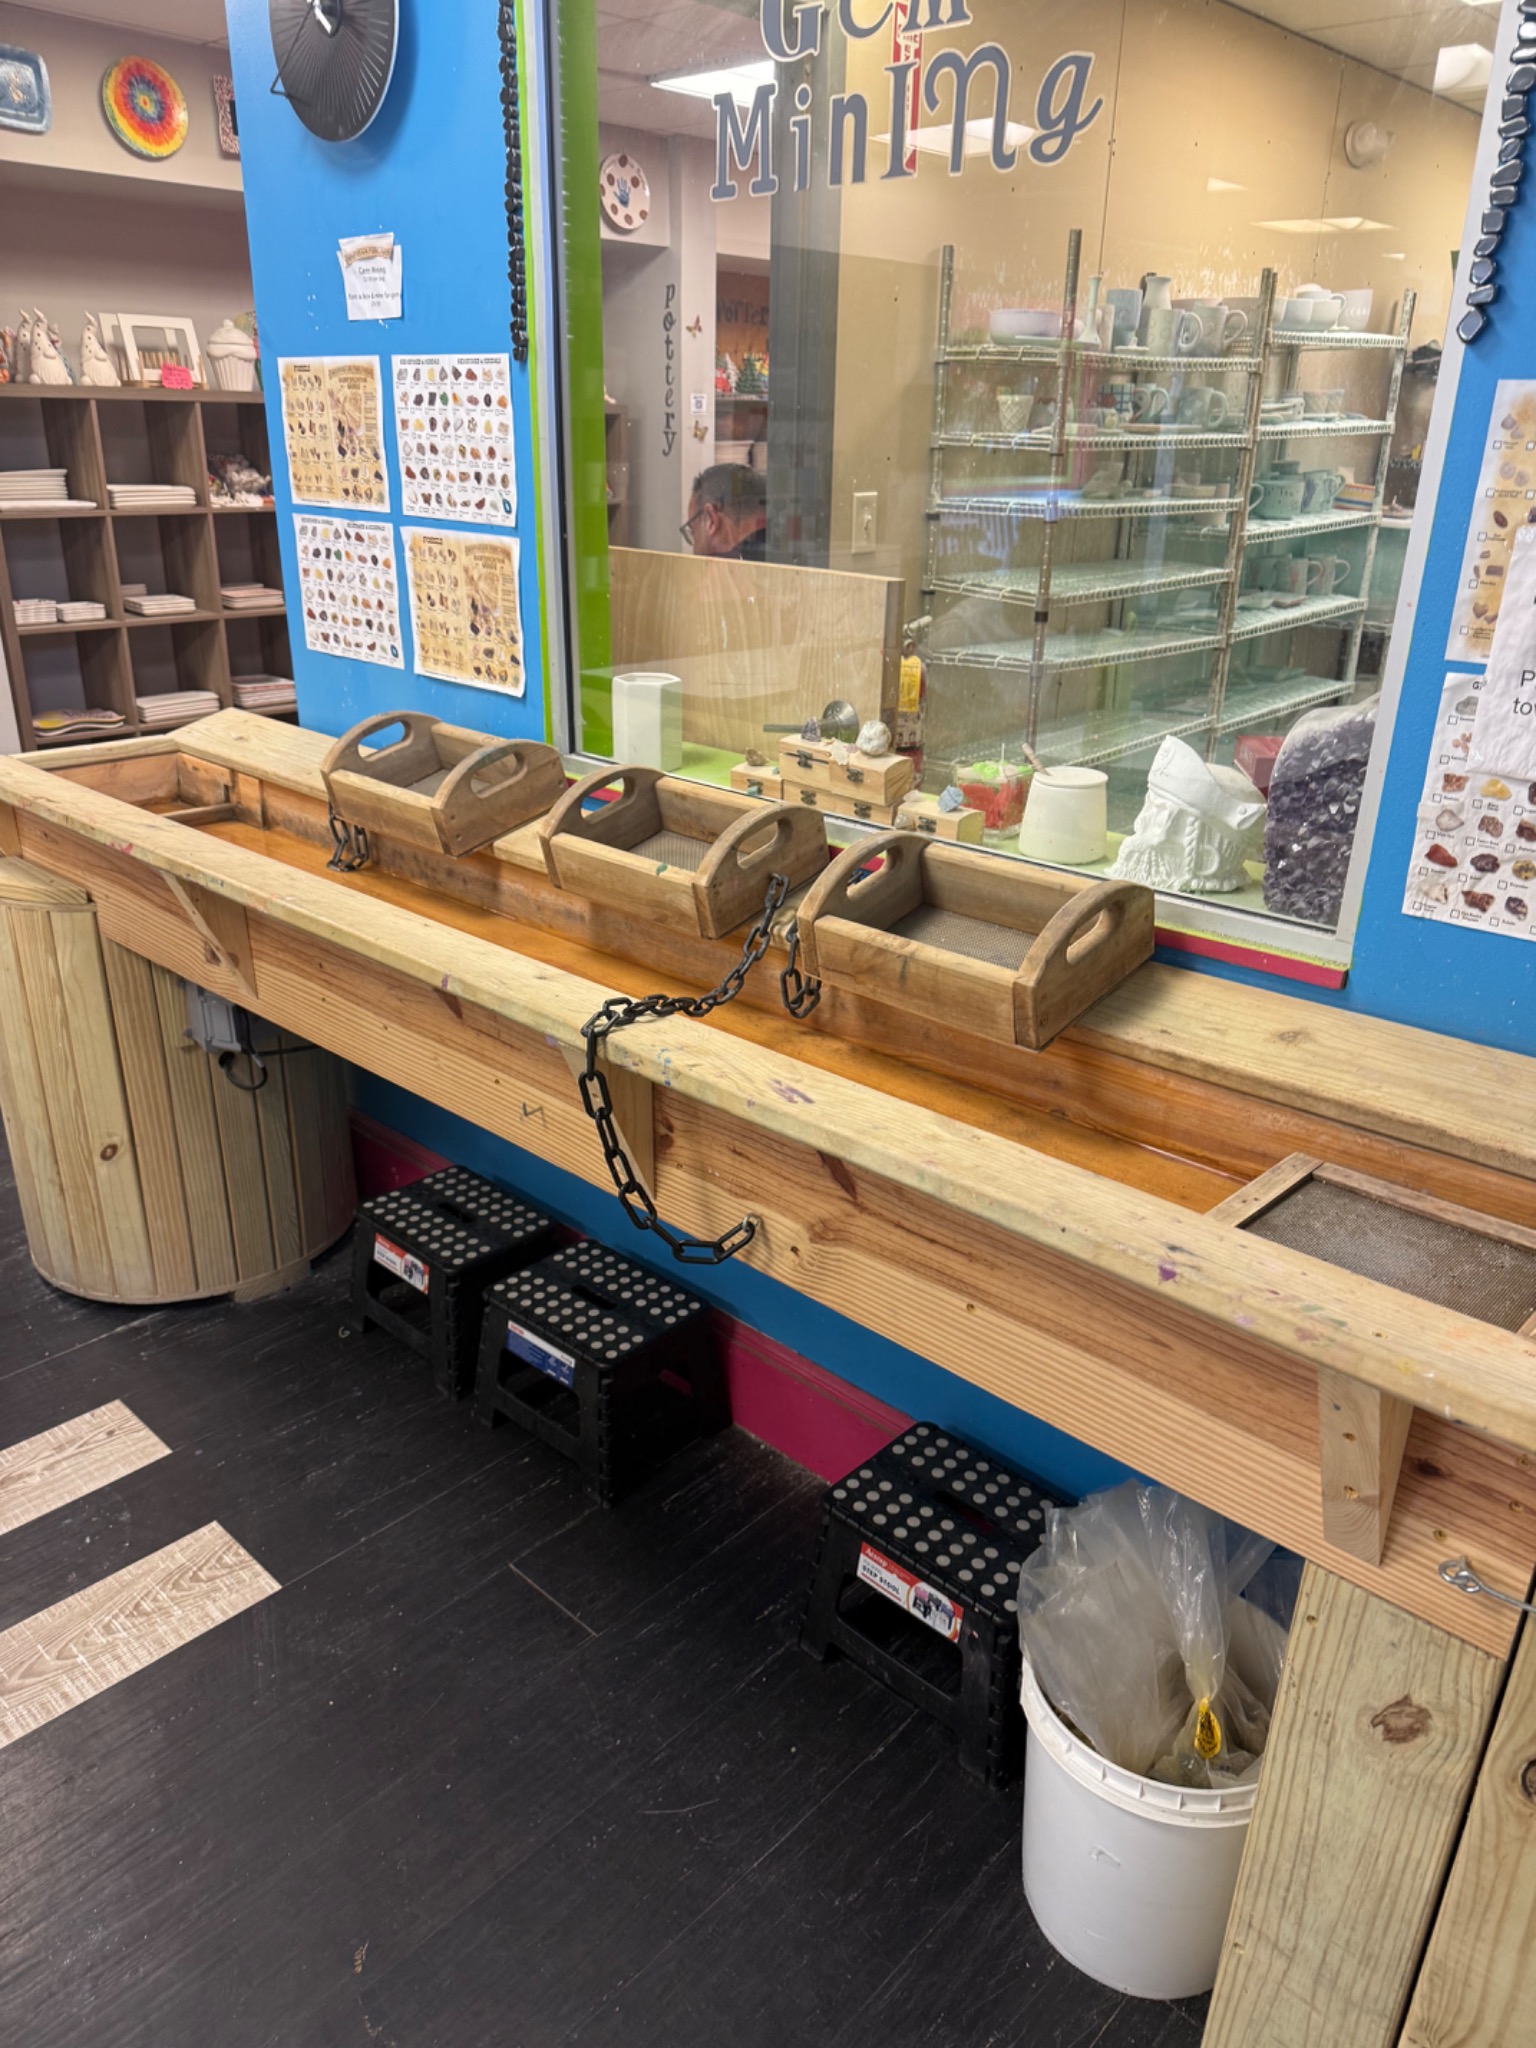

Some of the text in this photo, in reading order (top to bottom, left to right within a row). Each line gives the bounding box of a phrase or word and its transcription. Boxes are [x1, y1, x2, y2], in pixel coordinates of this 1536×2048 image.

[662, 283, 677, 457] pottery
[1520, 669, 1536, 690] P
[1512, 696, 1536, 716] to
[862, 1565, 878, 1578] STEP
[879, 1576, 901, 1595] STOOL
